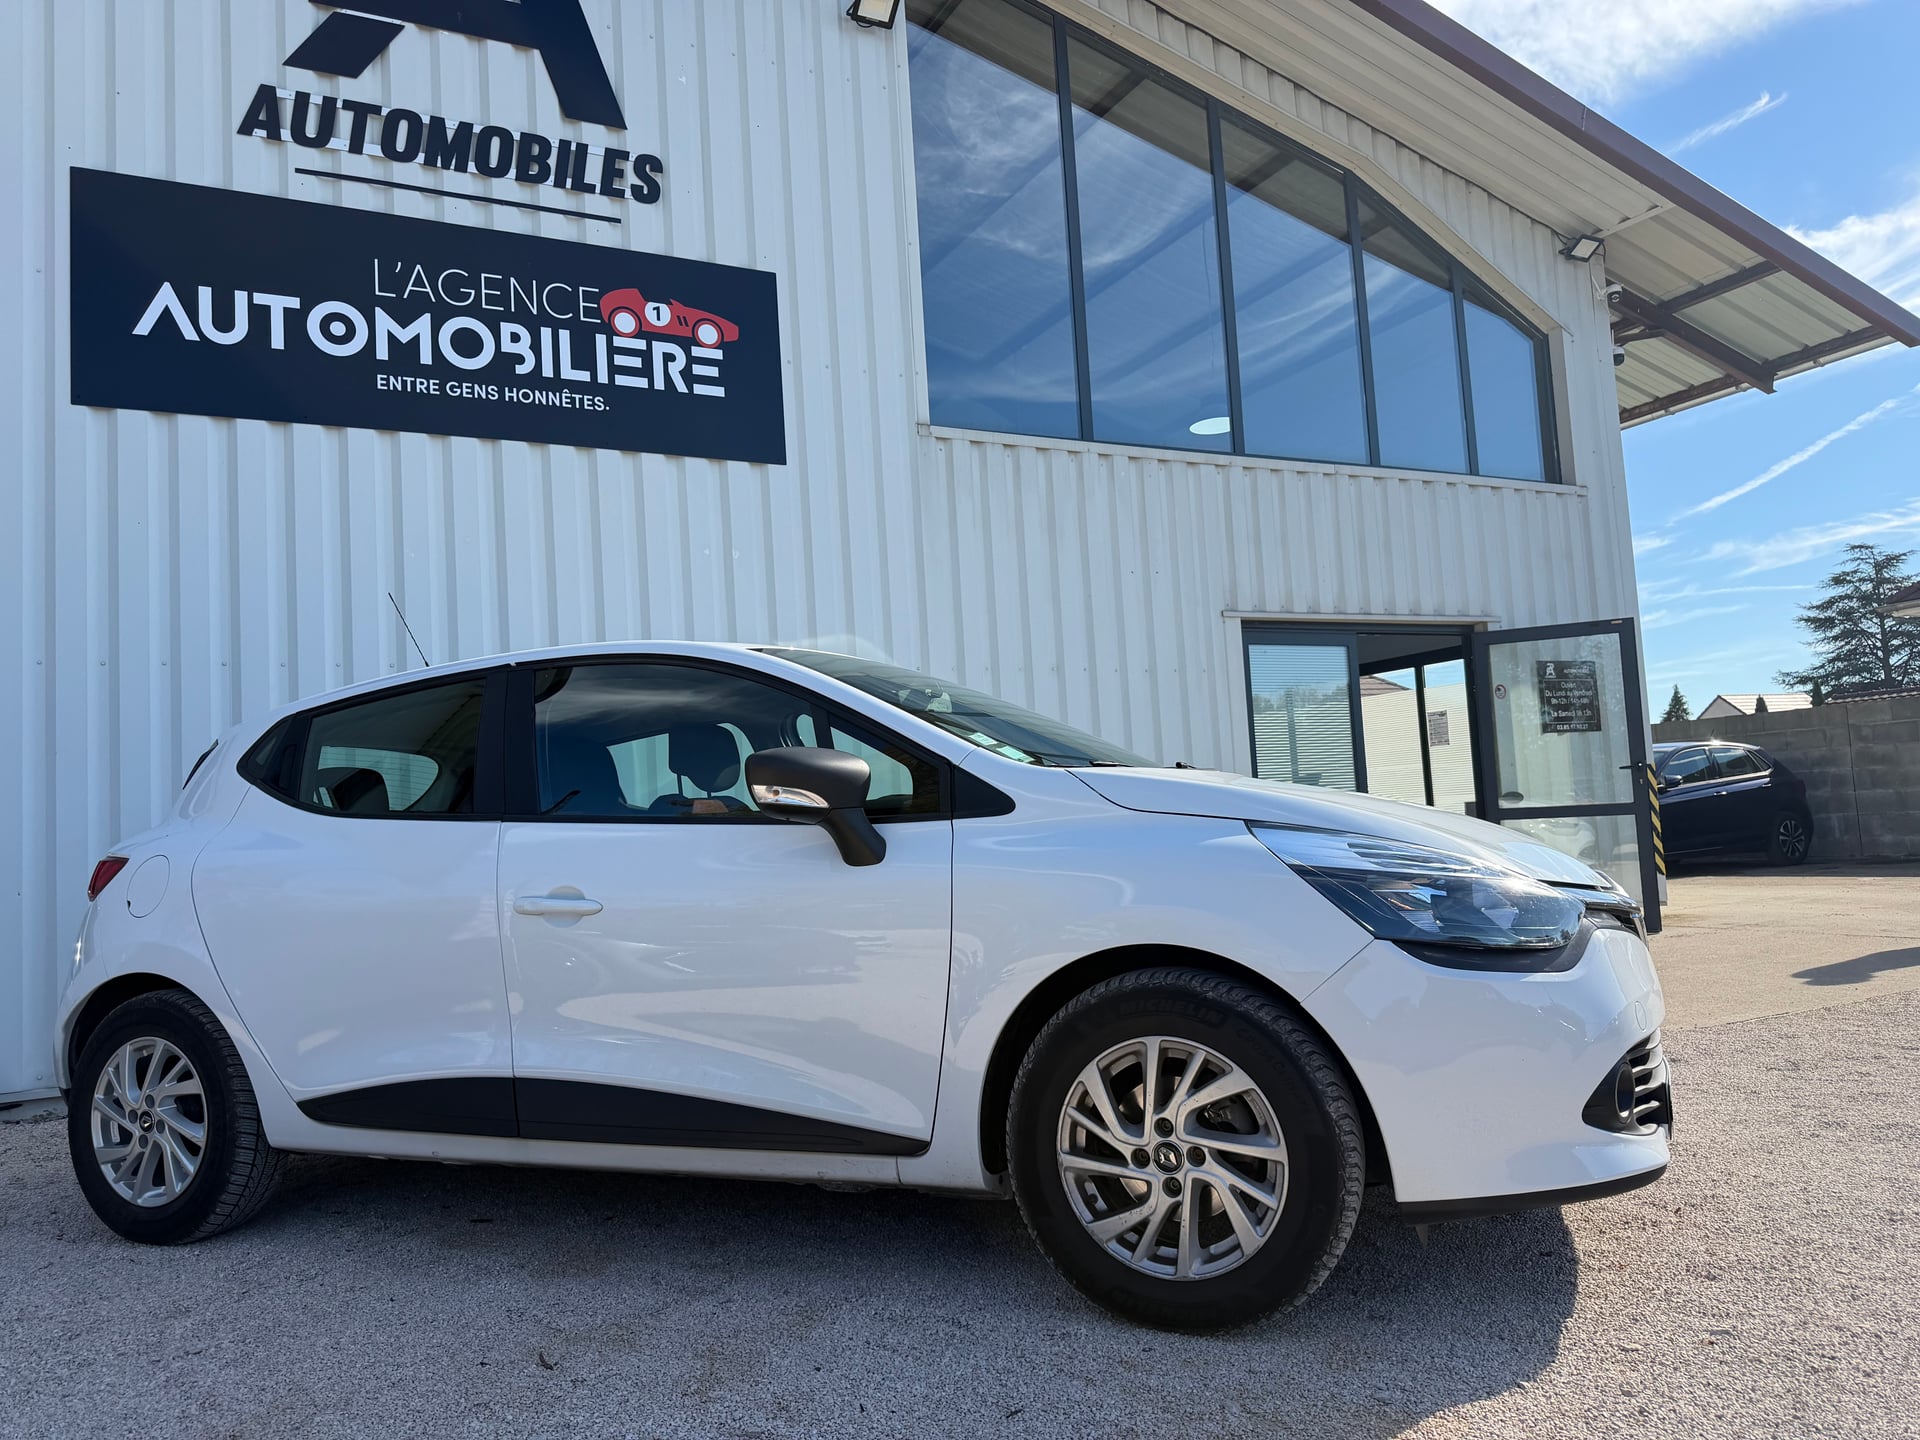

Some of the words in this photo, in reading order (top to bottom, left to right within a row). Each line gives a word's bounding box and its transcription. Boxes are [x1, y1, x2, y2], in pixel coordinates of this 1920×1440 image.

[237, 83, 664, 205] AUTOMOBILES
[374, 258, 601, 323] L'AGENCE
[376, 374, 440, 395] ENTRE
[445, 381, 499, 400] GENS
[504, 387, 610, 411] HONNÊTES.
